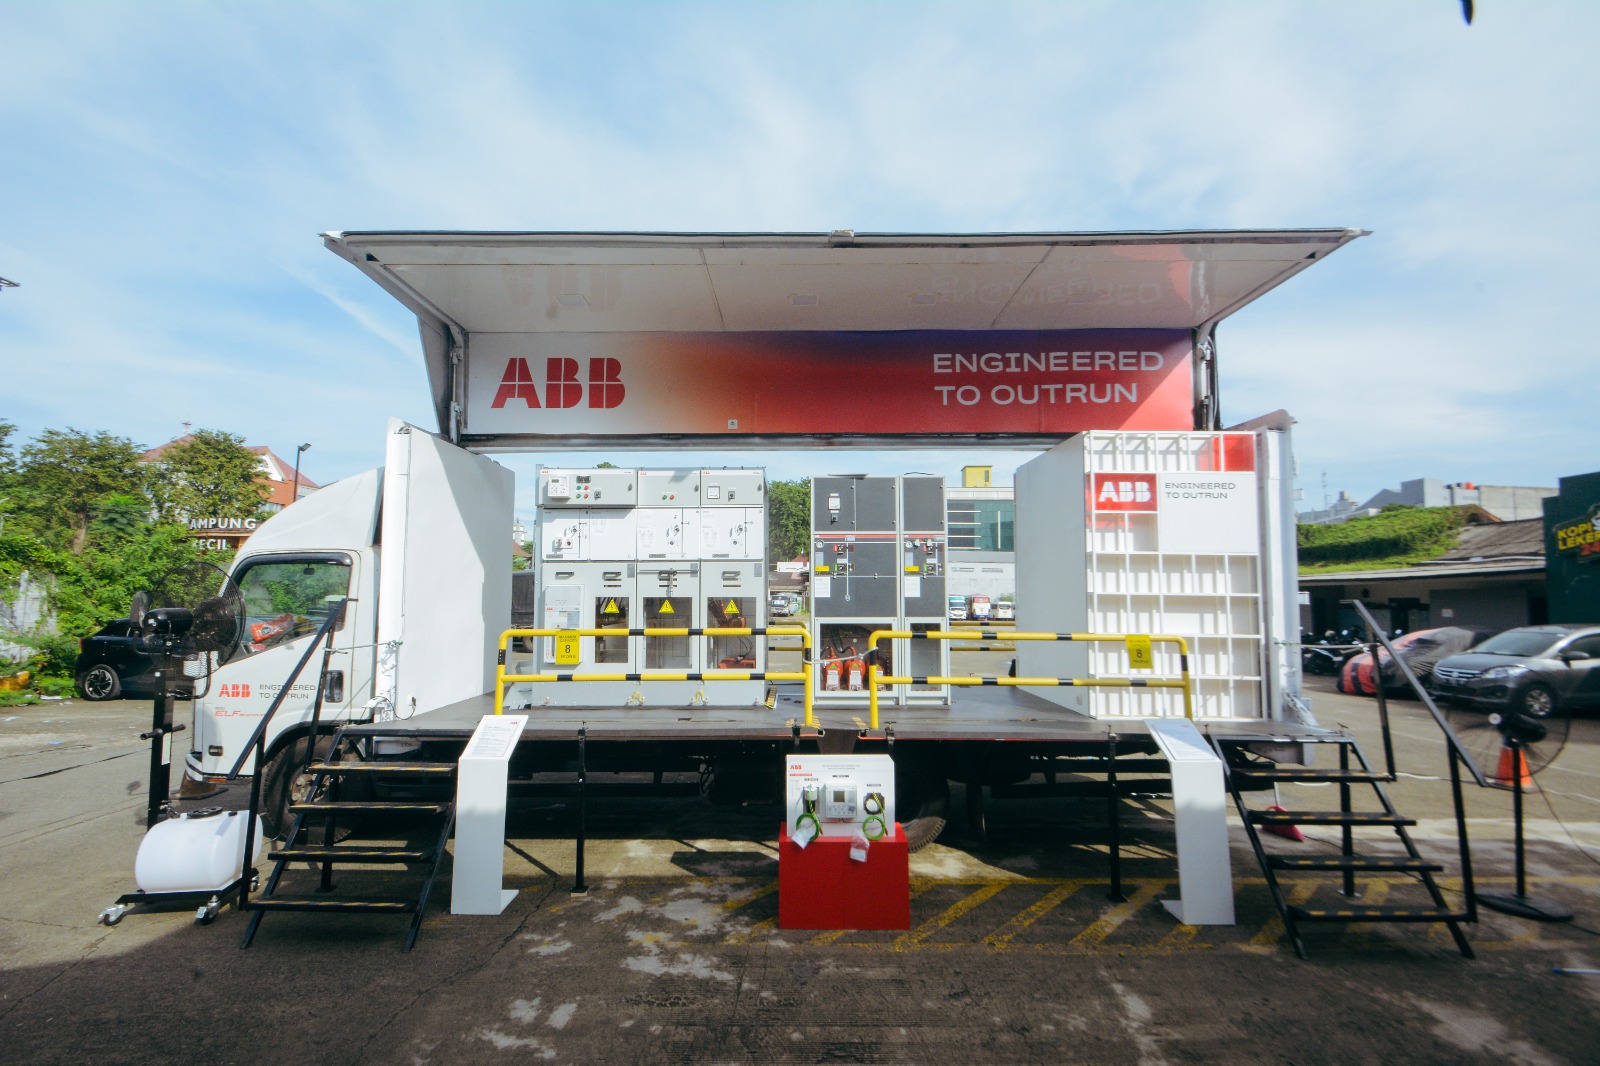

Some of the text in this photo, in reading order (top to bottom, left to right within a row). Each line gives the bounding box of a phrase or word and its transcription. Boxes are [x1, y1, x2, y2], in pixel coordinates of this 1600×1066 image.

[933, 351, 1164, 373] ENGINEERED
[491, 358, 626, 408] ABB
[934, 383, 1138, 406] TO OUTRUN
[1098, 481, 1152, 502] ABB
[1165, 482, 1236, 490] ENGINEERED
[1165, 491, 1228, 499] TO OUTRUN
[189, 517, 257, 529] AMPUNG
[1558, 522, 1592, 539] KOPI
[565, 644, 571, 654] 8
[1136, 648, 1143, 658] 8
[218, 684, 250, 698] ABB
